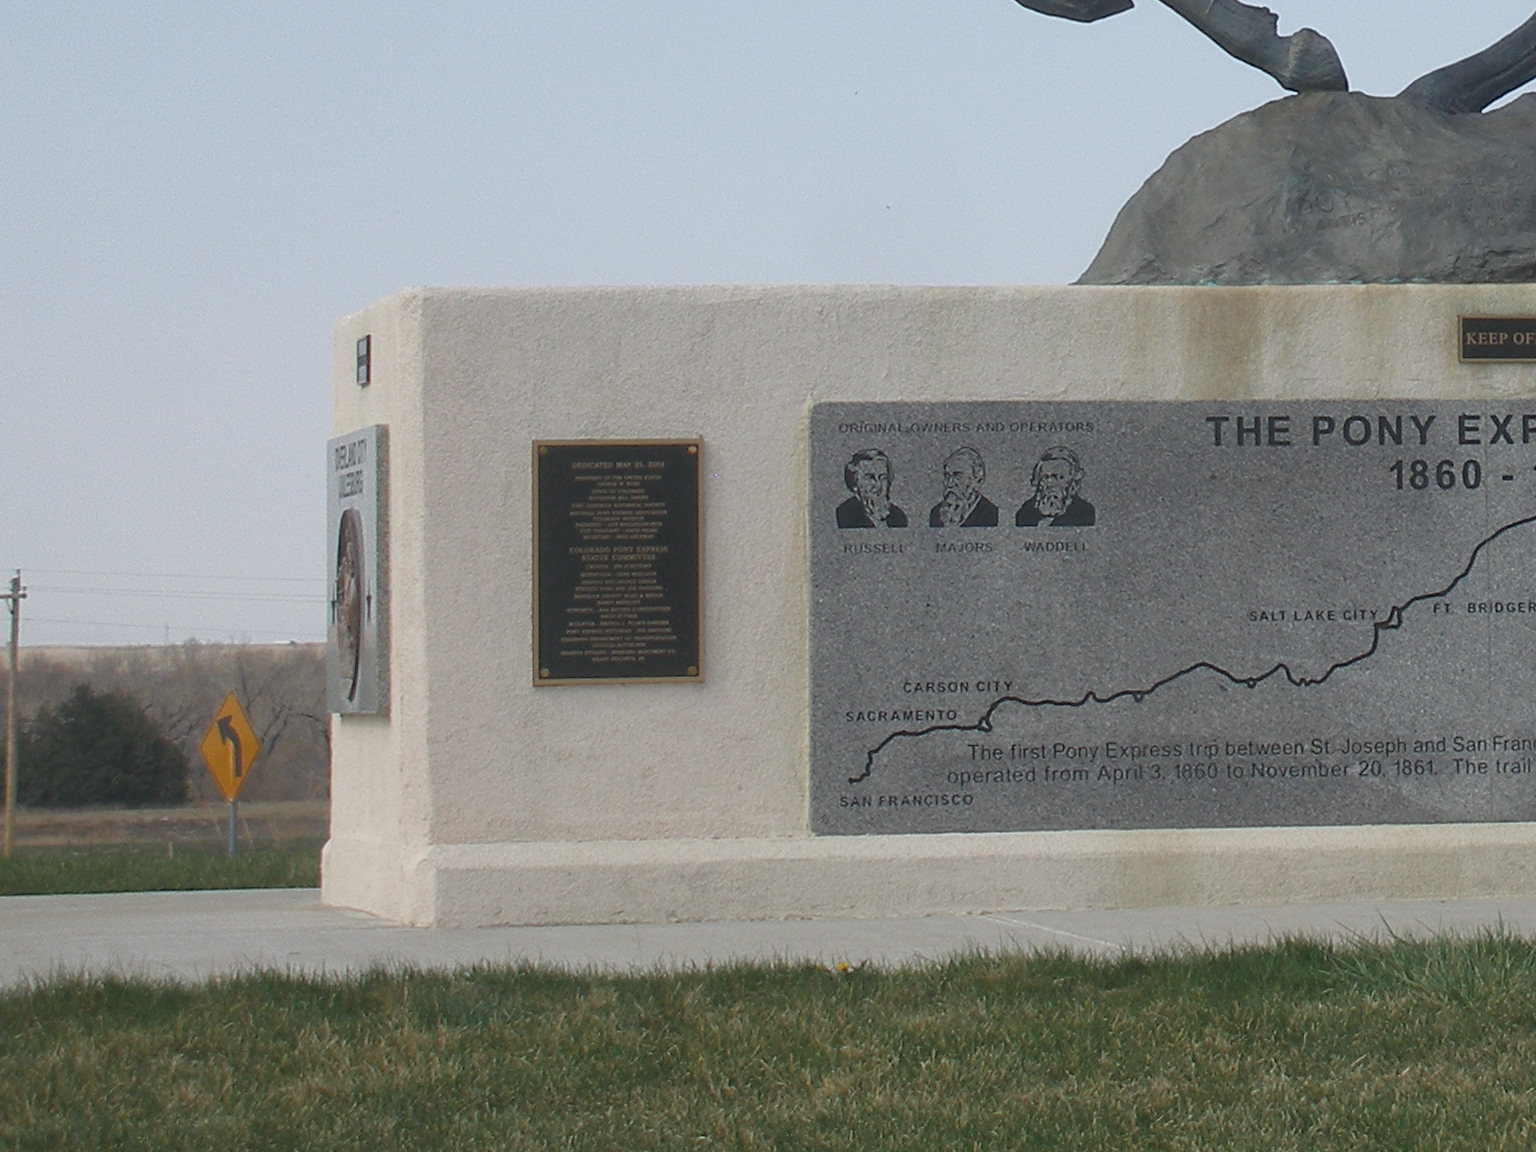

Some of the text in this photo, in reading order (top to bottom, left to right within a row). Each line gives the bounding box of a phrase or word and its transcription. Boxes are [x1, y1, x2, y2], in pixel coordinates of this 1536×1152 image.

[1466, 332, 1508, 345] KEEP
[838, 421, 1095, 434] ORIGINAL OWNERS AND OPERATORS
[1206, 415, 1292, 447] THE
[1312, 415, 1436, 446] PONY
[1390, 459, 1482, 490] 1860
[843, 543, 904, 554] RUSSELL
[936, 542, 993, 553] MAJORS
[1024, 541, 1087, 553] WADDELL
[1467, 602, 1536, 614] BRIDGER
[1250, 609, 1379, 622] SALT LAKE CITY
[903, 681, 1013, 693] CARSON CITY
[845, 710, 957, 722] SACRAMENTO
[968, 743, 1003, 760] The
[1008, 743, 1046, 760] first
[1052, 743, 1099, 766] Pony
[1105, 742, 1182, 762] Express
[1189, 740, 1219, 760] trip
[1225, 739, 1304, 757] between
[1341, 737, 1407, 758] Joseph
[1413, 737, 1446, 753] and
[1452, 736, 1487, 752] San
[947, 766, 1036, 786] operated
[1044, 765, 1089, 782] from
[1097, 765, 1143, 784] April
[1176, 763, 1218, 780] 1860
[1227, 763, 1244, 779] to
[1251, 762, 1351, 779] November
[1453, 759, 1488, 775] The
[1496, 758, 1532, 774] trail
[840, 795, 974, 808] SAN FRANCISCO
